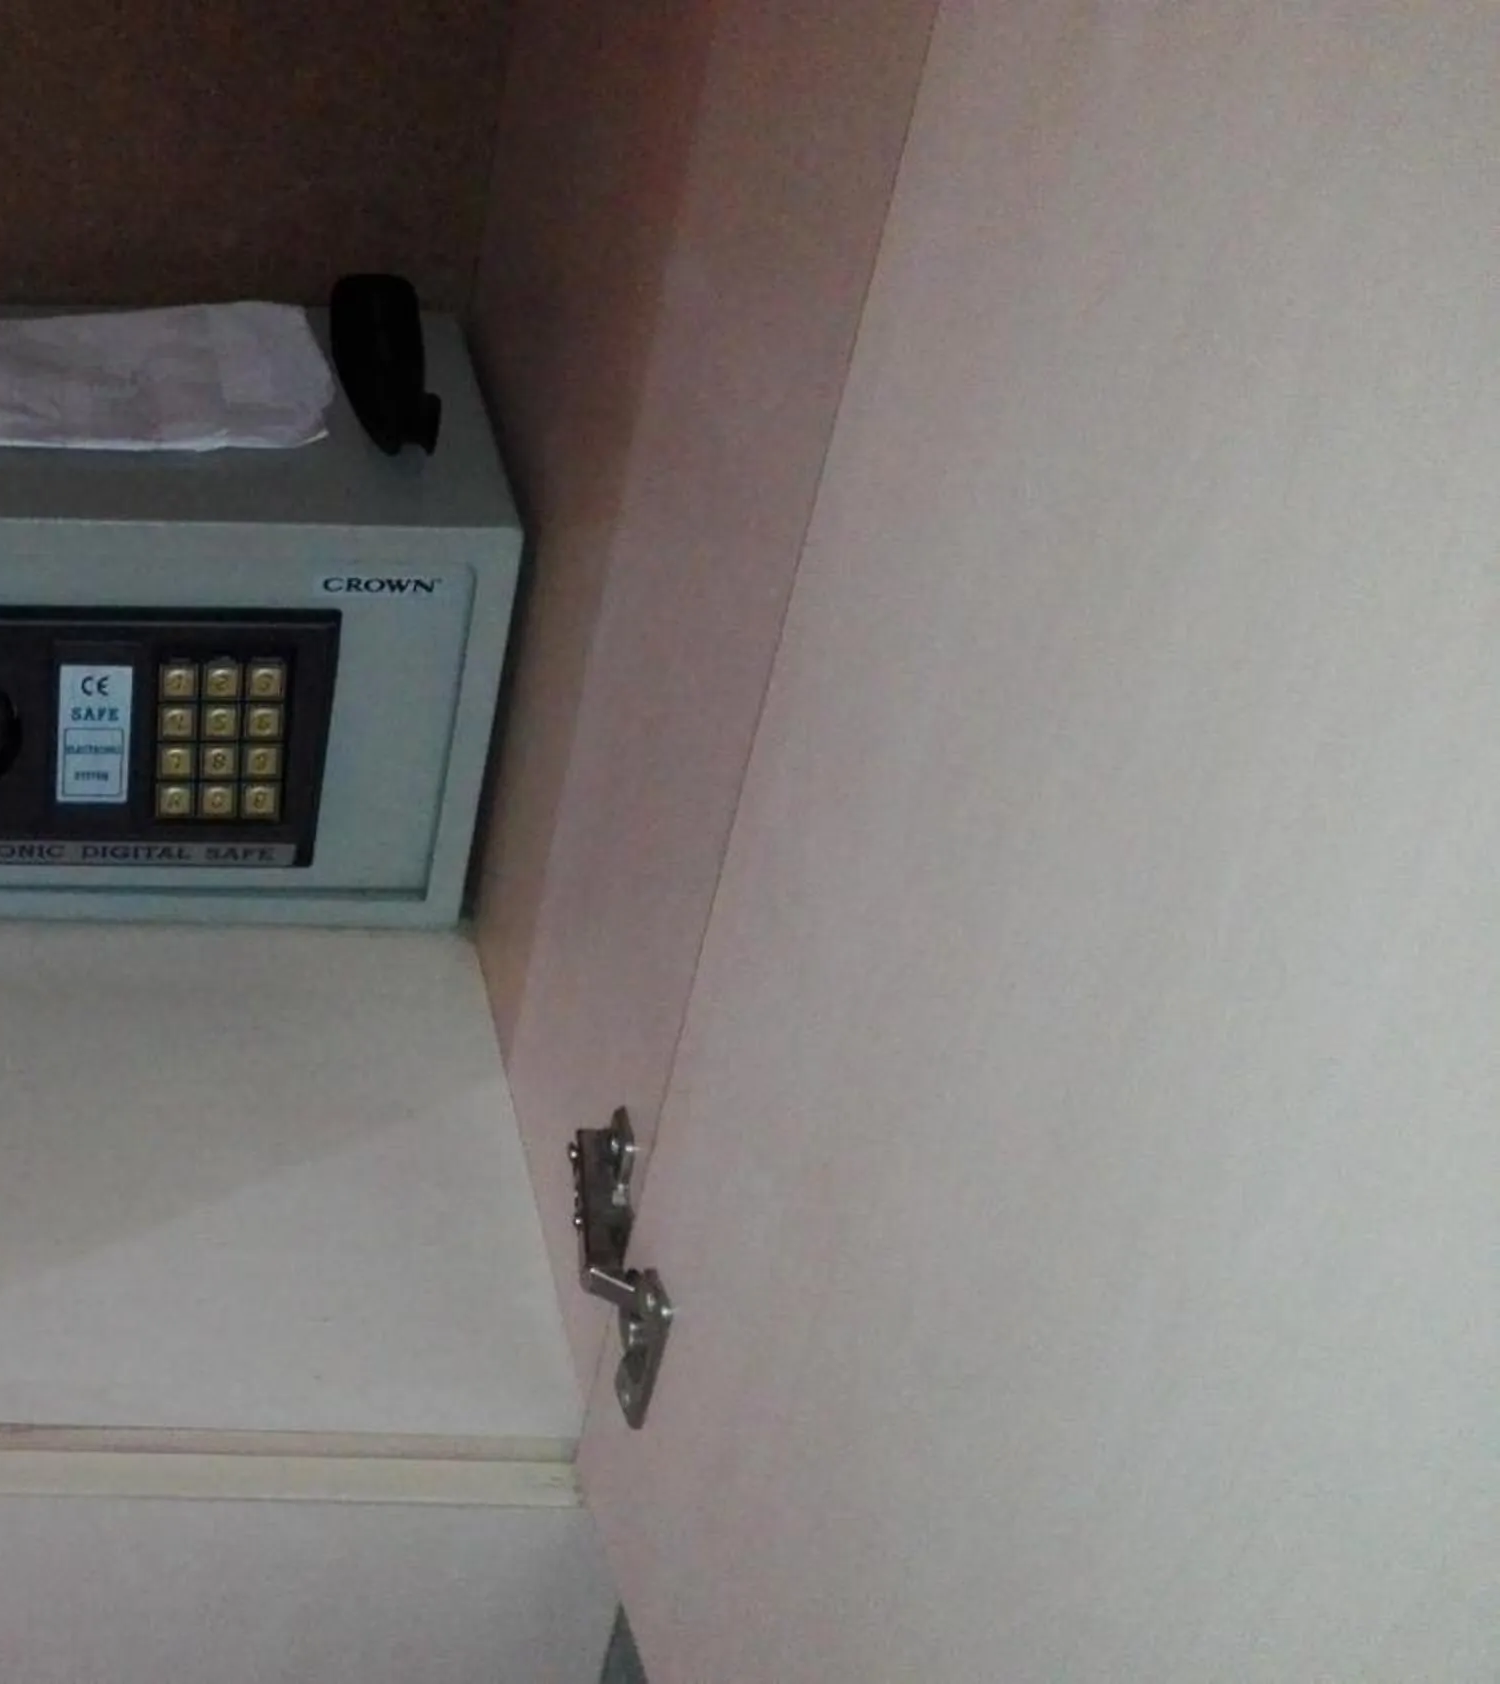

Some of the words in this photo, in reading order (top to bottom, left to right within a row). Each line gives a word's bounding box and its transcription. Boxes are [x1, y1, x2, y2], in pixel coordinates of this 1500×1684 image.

[323, 577, 436, 593] CROWN
[71, 706, 120, 721] SAFE
[81, 844, 192, 862] DIGITAL
[205, 846, 275, 862] SAFE
